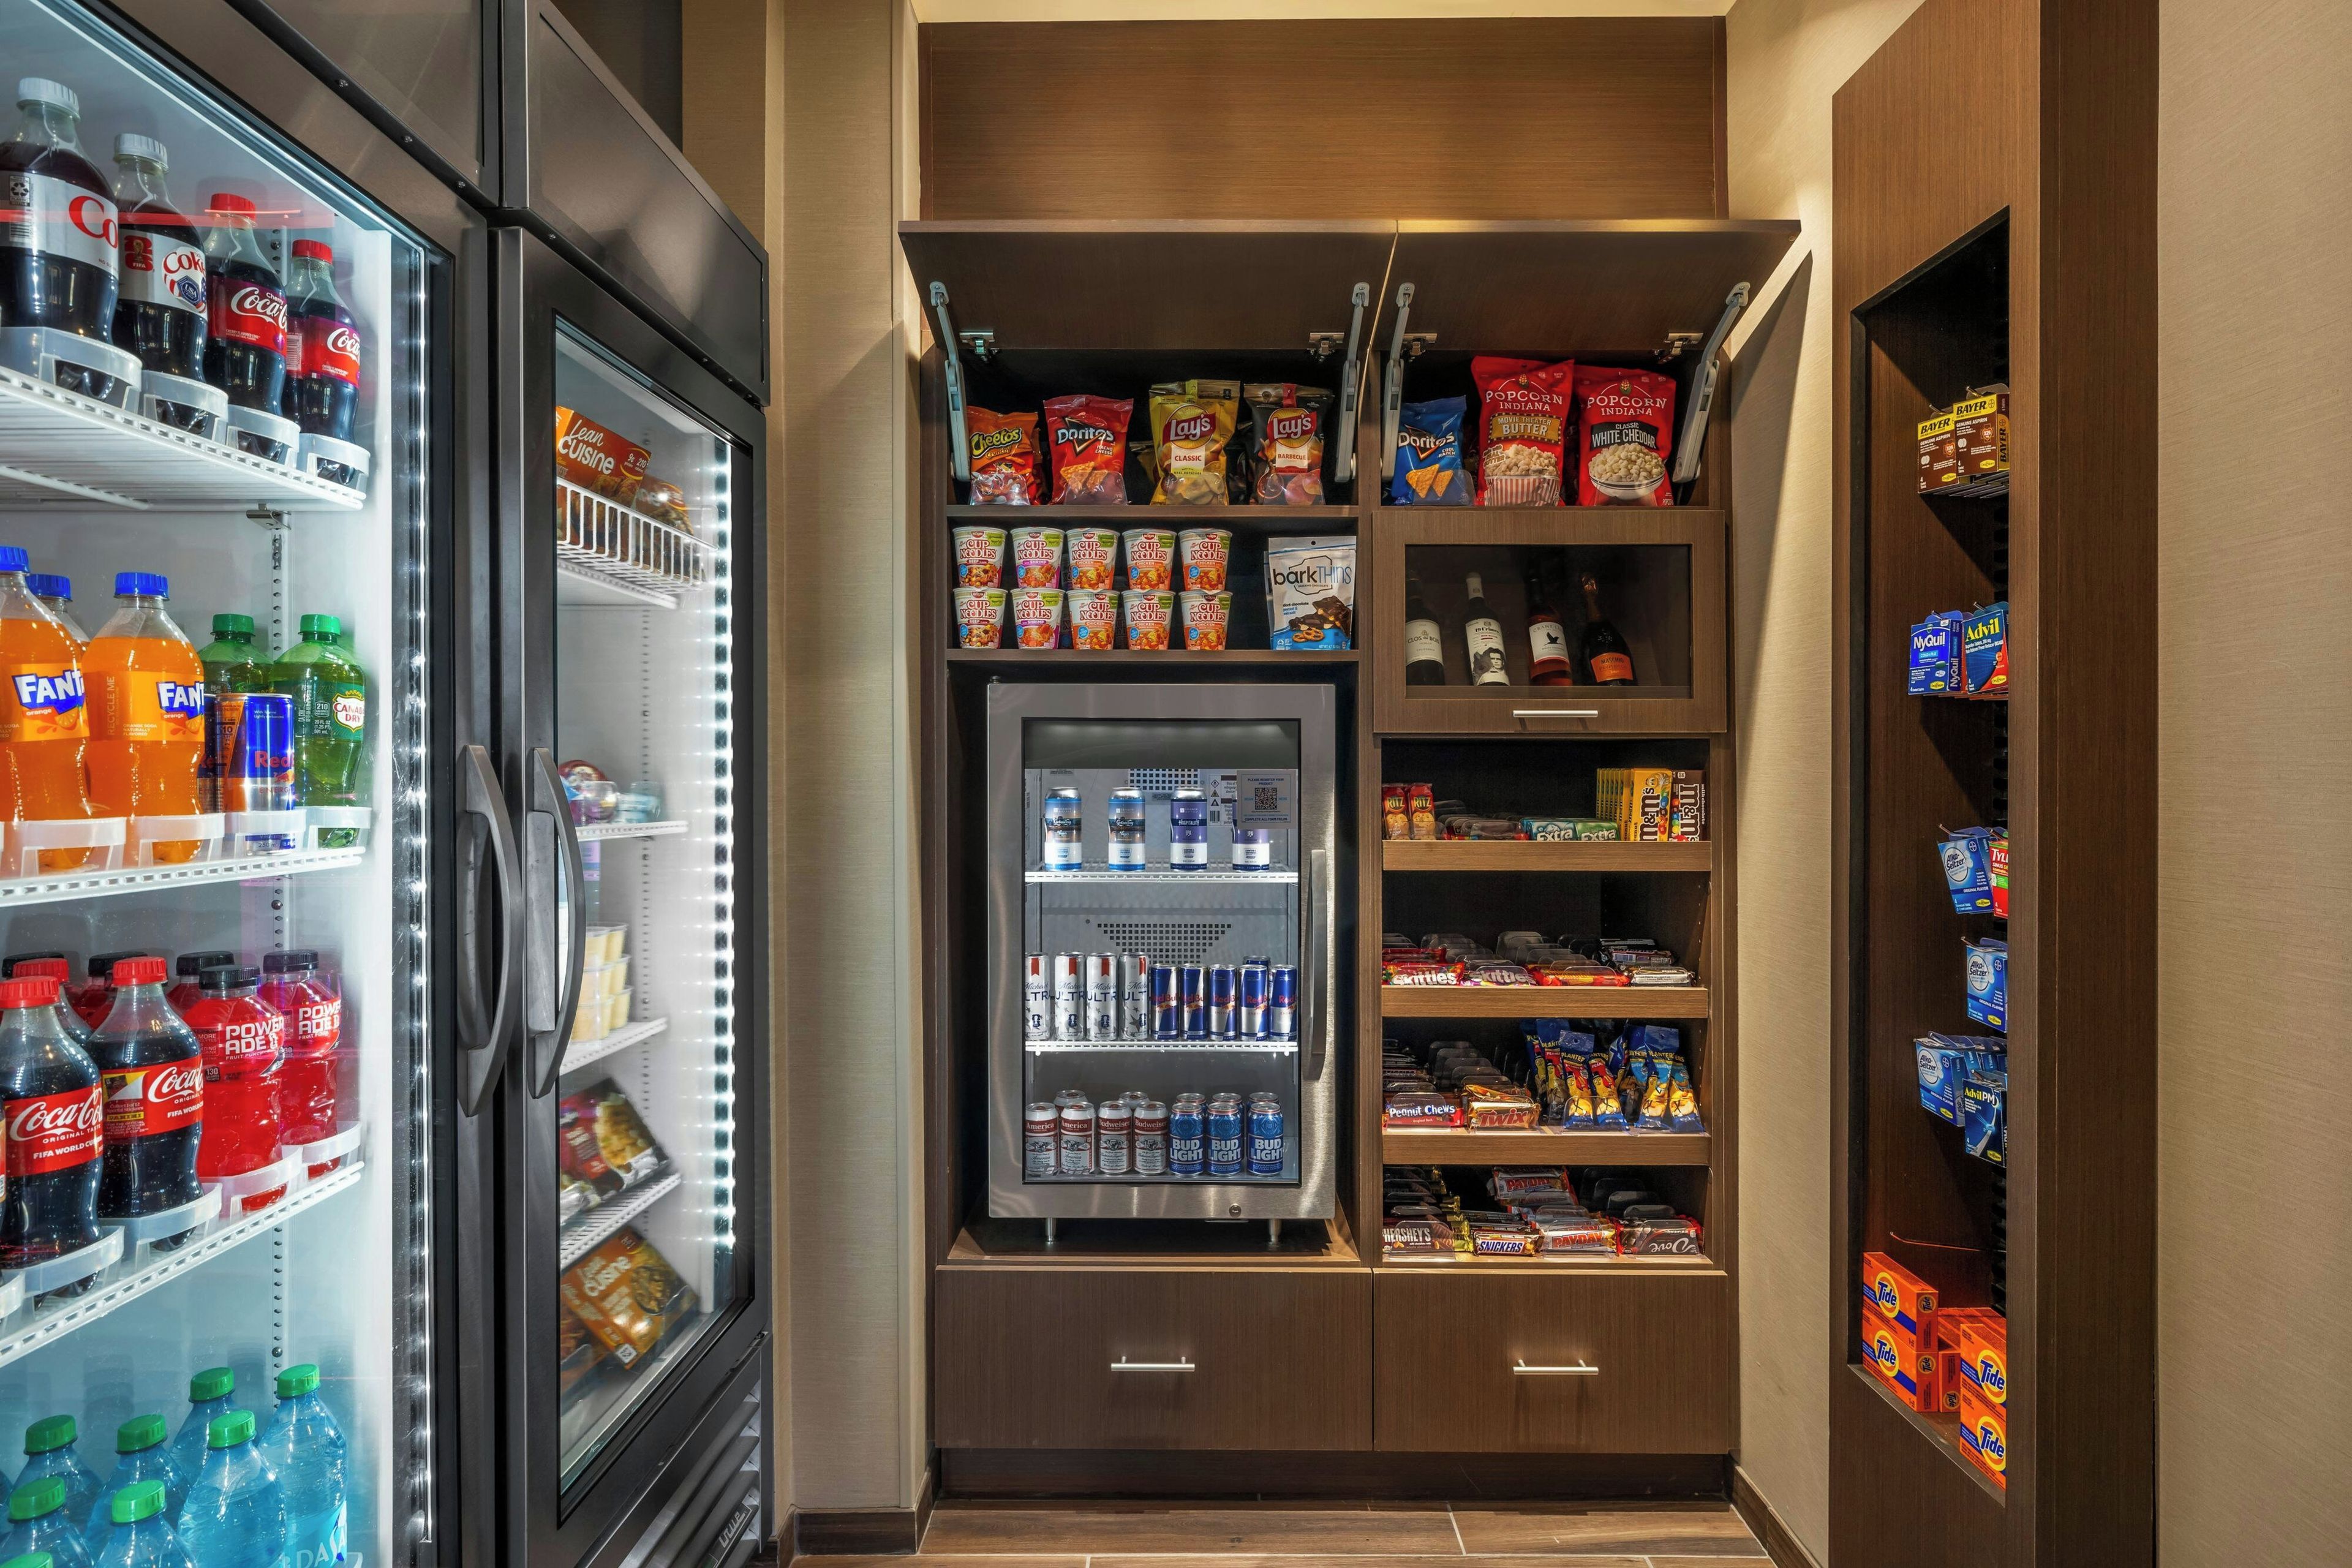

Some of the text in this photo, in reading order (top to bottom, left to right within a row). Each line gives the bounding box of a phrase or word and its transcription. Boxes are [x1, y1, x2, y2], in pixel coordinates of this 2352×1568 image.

[184, 284, 197, 297] USA
[266, 292, 284, 305] Cherry
[1486, 390, 1563, 405] POPCORN
[1587, 396, 1667, 409] POPCORN
[1499, 402, 1551, 412] INDIANA
[1601, 407, 1653, 416] INDIANA
[1956, 400, 1987, 415] BAYER
[1170, 413, 1212, 440] Lay's
[1273, 413, 1311, 439] Lay's
[1522, 417, 1551, 426] THEATER
[1920, 418, 1951, 435] BAYER
[569, 420, 604, 447] Lean
[1502, 423, 1548, 436] BUTTER
[971, 428, 1022, 456] Cheetos
[1057, 429, 1114, 445] Doritos
[1398, 431, 1455, 448] Doritos
[1592, 429, 1656, 449] WHITE CHEDDAR
[1920, 433, 1951, 446] GENUINE ASPIRIN
[985, 447, 1011, 458] Crunchy
[636, 458, 647, 468] 210
[966, 540, 990, 549] CUP
[1023, 540, 1047, 551] CUP
[1077, 541, 1101, 551] CUP
[1137, 541, 1161, 551] CUP
[1199, 541, 1221, 552] CUP
[960, 549, 997, 559] NOODLES
[1018, 549, 1054, 560] NOODLES
[1072, 550, 1107, 560] NOODLES
[1131, 551, 1167, 561] NOODLES
[1191, 551, 1226, 562] NOODLES
[967, 600, 990, 610] CUP
[1021, 600, 1045, 610] CUP
[1088, 602, 1110, 612] CUP
[1137, 603, 1161, 612] CUP
[1198, 603, 1221, 612] CUP
[960, 609, 997, 619] NOODLES
[1016, 609, 1052, 620] NOODLES
[1080, 611, 1114, 620] NOODLES
[1131, 612, 1166, 622] NOODLES
[1190, 612, 1225, 622] NOODLES
[1965, 617, 2000, 642] Advil
[1913, 631, 1945, 652] NyQuil
[1950, 658, 1960, 687] NyQuil
[107, 676, 115, 736] RECYCLE ME
[345, 714, 361, 723] DRY
[1387, 797, 1405, 807] RITZ
[1414, 797, 1431, 807] RITZ
[1639, 787, 1660, 841] m&m's
[1537, 829, 1573, 841] Extra
[1581, 829, 1616, 841] Extra
[1947, 853, 1960, 864] Alka-
[1947, 858, 1964, 871] Seltzer
[1970, 960, 1984, 970] Alka-
[1392, 970, 1458, 986] Skittles
[1469, 969, 1536, 986] Skittles
[1969, 968, 1988, 977] Seltzer
[1979, 998, 1992, 1008] ORIGINAL
[225, 1035, 266, 1055] ADE
[1920, 1061, 1936, 1071] Seltzer
[174, 1093, 200, 1104] ORIGINAL
[1930, 1091, 1943, 1101] ORIGINAL
[1943, 1097, 1954, 1106] FLAVOR
[1964, 1087, 1981, 1100] Advil
[1981, 1092, 1995, 1104] PM
[167, 1110, 183, 1118] FIFA
[1389, 1104, 1455, 1117] Peanut Chews
[1061, 1120, 1087, 1129] America
[1098, 1119, 1130, 1128] Budweiser
[1135, 1119, 1167, 1128] Budweiser
[42, 1131, 85, 1144] ORIGINAL
[1172, 1138, 1200, 1150] BUD
[1212, 1138, 1239, 1150] BUD
[1254, 1138, 1281, 1150] BUD
[33, 1144, 85, 1159] FIFA WORLD
[1170, 1148, 1203, 1161] LIGHT
[1208, 1148, 1241, 1161] LIGHT
[1251, 1147, 1284, 1161] LIGHT
[1382, 1227, 1431, 1242] HERSHEY'S
[1551, 1231, 1605, 1249] PAYDAY
[1478, 1241, 1523, 1253] SNICKERS
[1877, 1281, 1898, 1306] Tide
[1875, 1339, 1896, 1365] Tide
[1980, 1359, 2005, 1392] Tide
[1949, 1392, 1958, 1408] Tide
[1979, 1425, 2005, 1458] Tide
